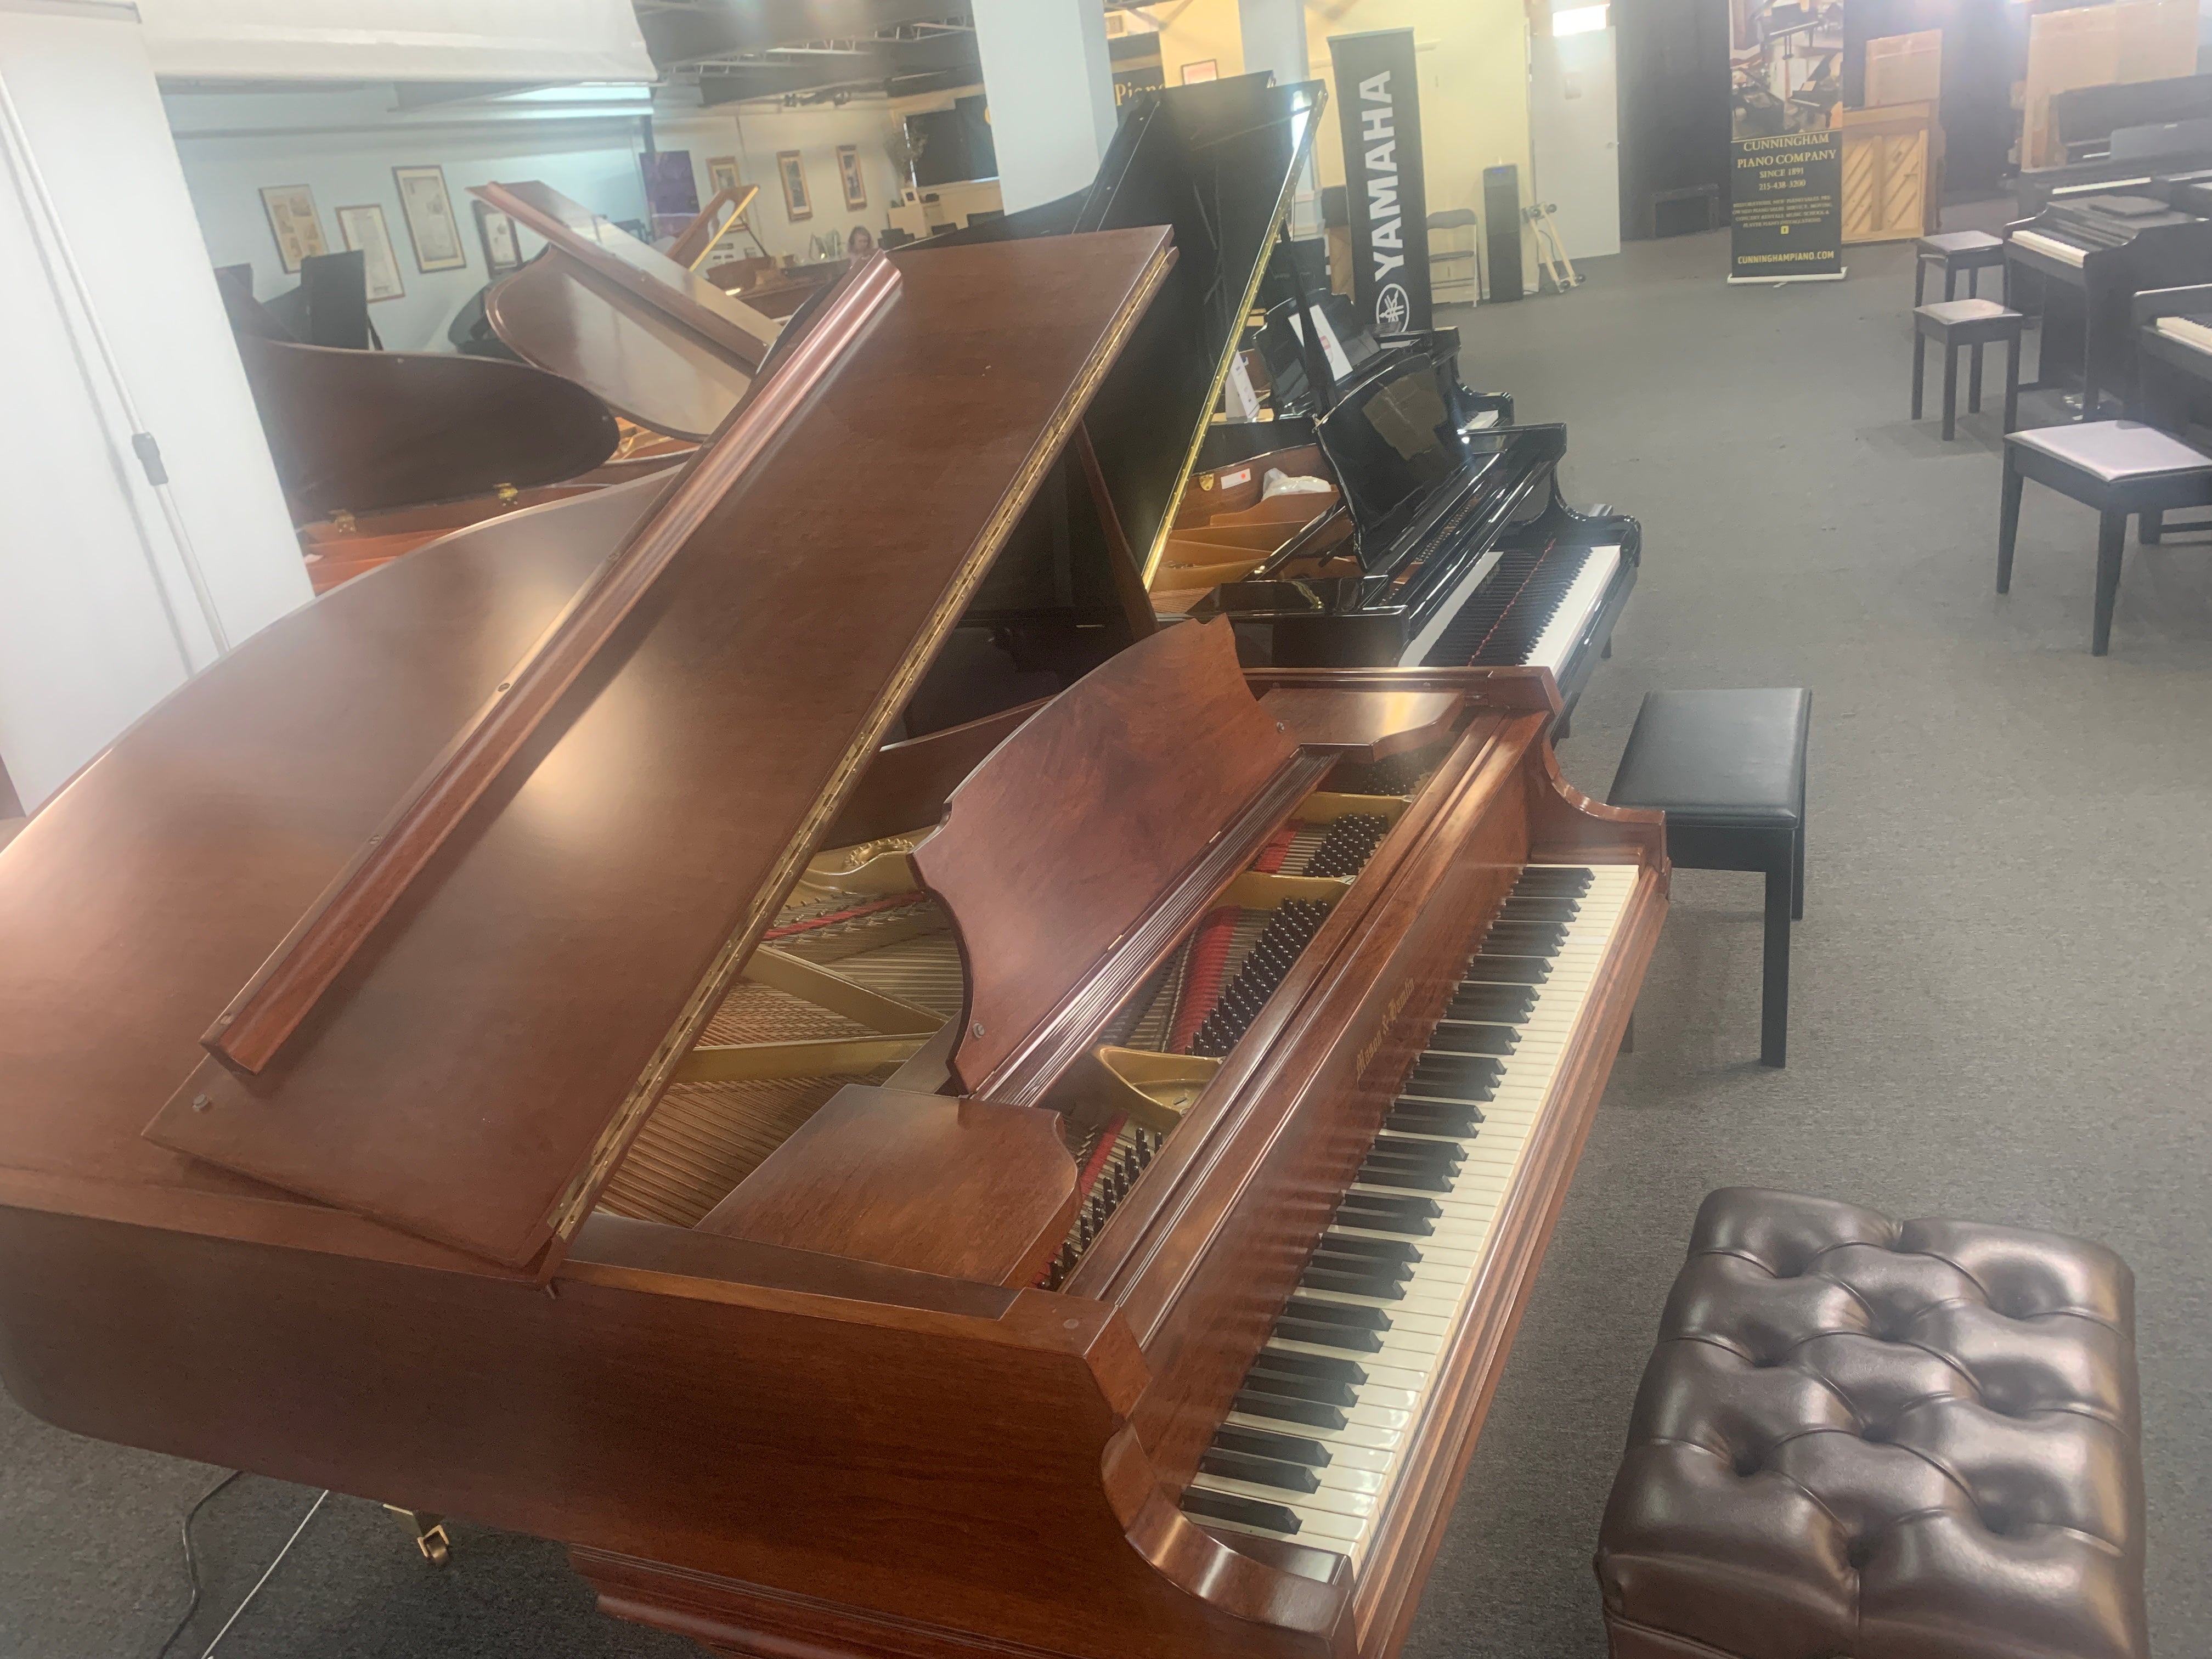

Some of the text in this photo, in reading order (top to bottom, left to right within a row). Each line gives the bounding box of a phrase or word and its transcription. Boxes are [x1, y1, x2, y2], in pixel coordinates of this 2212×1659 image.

[1743, 133, 1830, 151] CUNNINGHAM
[1737, 149, 1837, 168] PIANO COMPANY
[1359, 70, 1404, 282] YAMAHA
[1759, 167, 1804, 179] SINCE 1891
[1759, 179, 1807, 191] 215-438-3200
[1738, 251, 1835, 264] CUNNINGHAMPIANO.COM
[1357, 1030, 1382, 1085] Mason
